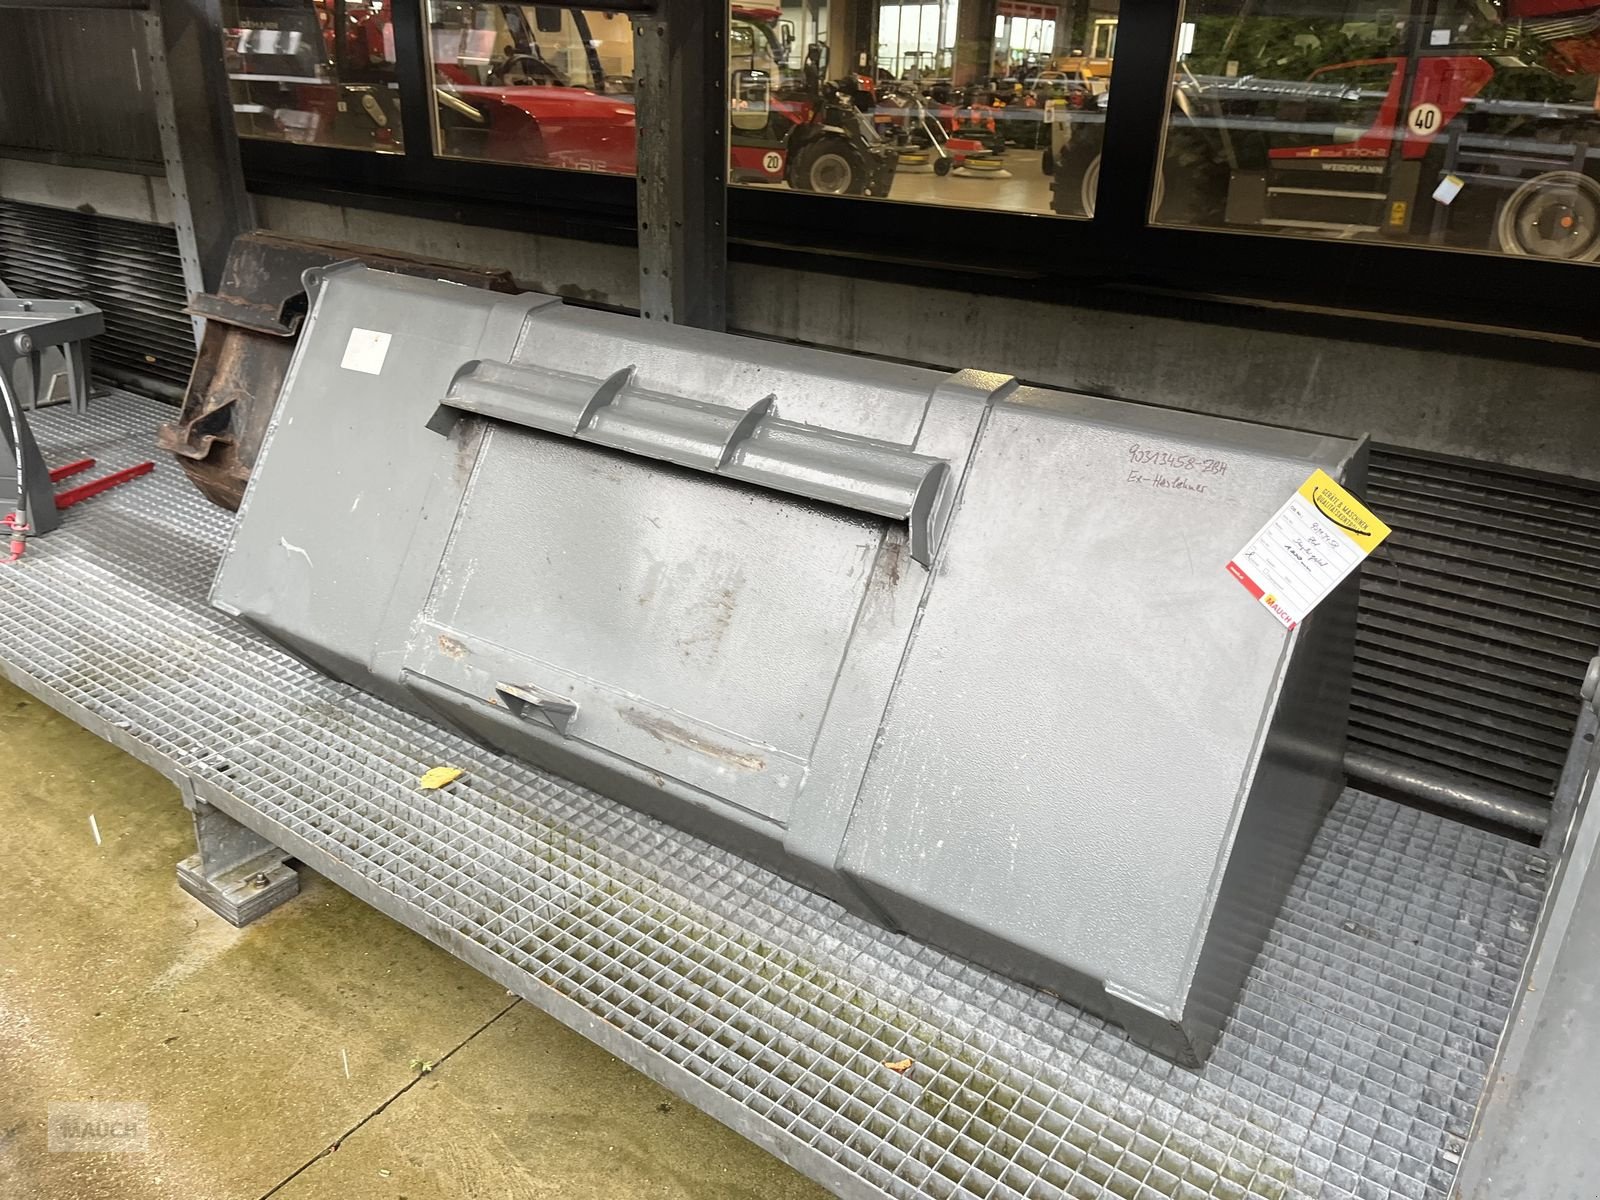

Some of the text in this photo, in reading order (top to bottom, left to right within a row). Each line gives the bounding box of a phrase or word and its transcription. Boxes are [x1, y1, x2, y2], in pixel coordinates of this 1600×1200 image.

[1415, 109, 1434, 129] 40
[767, 155, 779, 168] 20
[1321, 162, 1384, 174] WEIDEMANN
[1342, 504, 1370, 530] MASCHINEN
[1264, 596, 1292, 623] MAUCH
